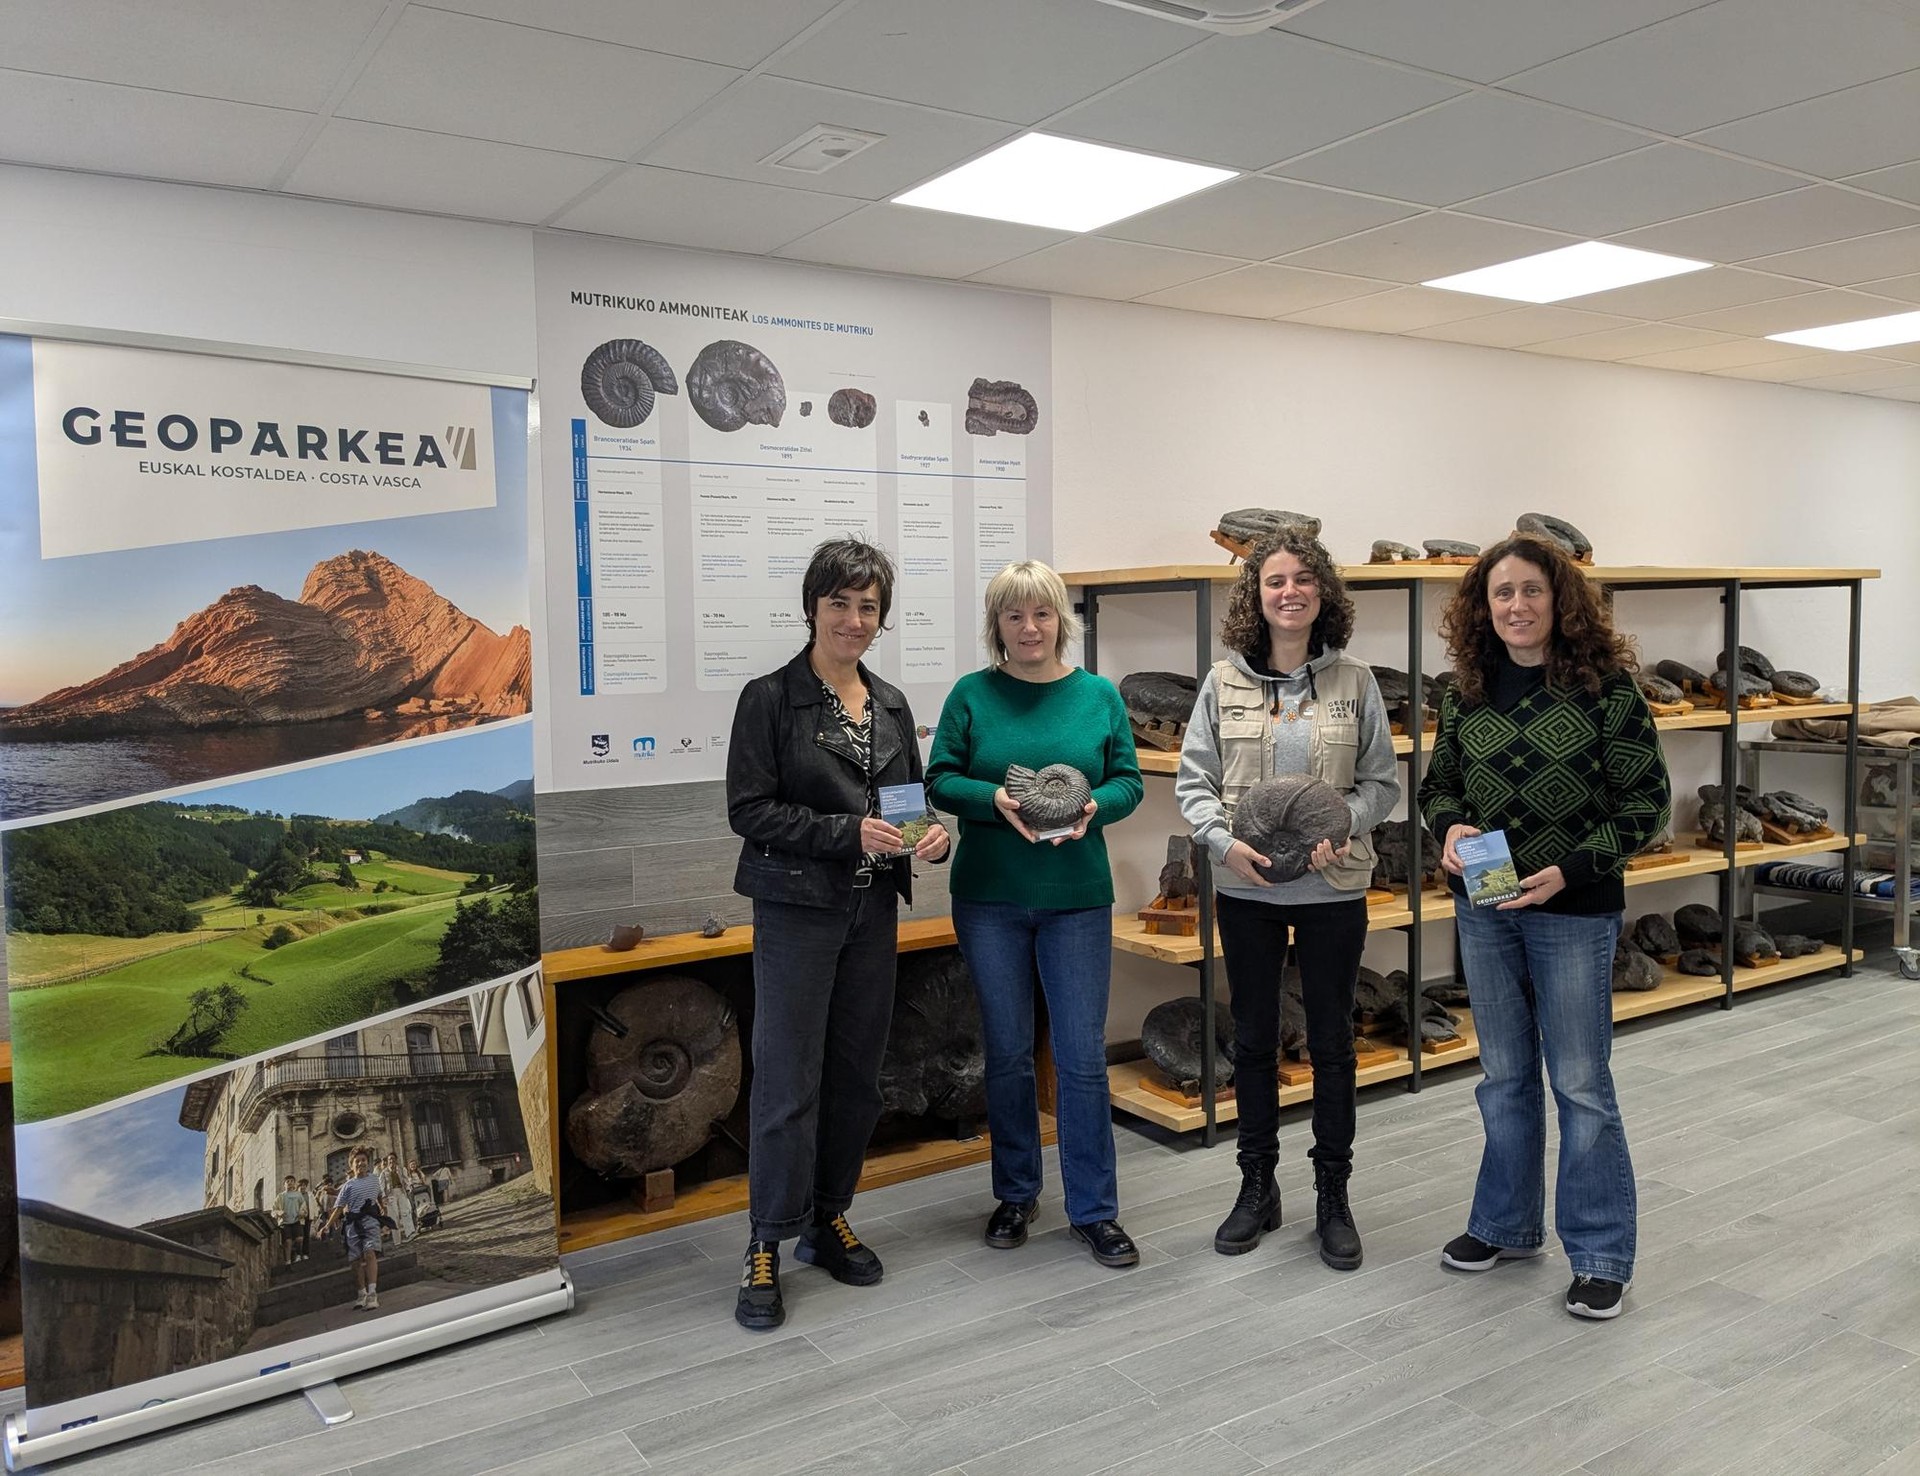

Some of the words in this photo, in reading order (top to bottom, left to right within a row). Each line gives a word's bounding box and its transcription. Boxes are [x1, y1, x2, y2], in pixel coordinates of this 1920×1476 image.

[570, 291, 655, 312] MUTRIKUKO
[659, 301, 749, 323] AMMONITEAK
[752, 314, 769, 324] LOS
[771, 317, 822, 331] AMMONITES
[823, 322, 835, 332] DE
[836, 324, 874, 336] MUTRIKU
[62, 406, 448, 469] GEOPARKEA
[139, 461, 206, 477] EUSKAL
[211, 465, 307, 482] KOSTALDEA
[319, 472, 369, 487] COSTA
[372, 475, 422, 489] VASCA
[1327, 699, 1346, 707] GEO
[1330, 712, 1349, 720] KEA
